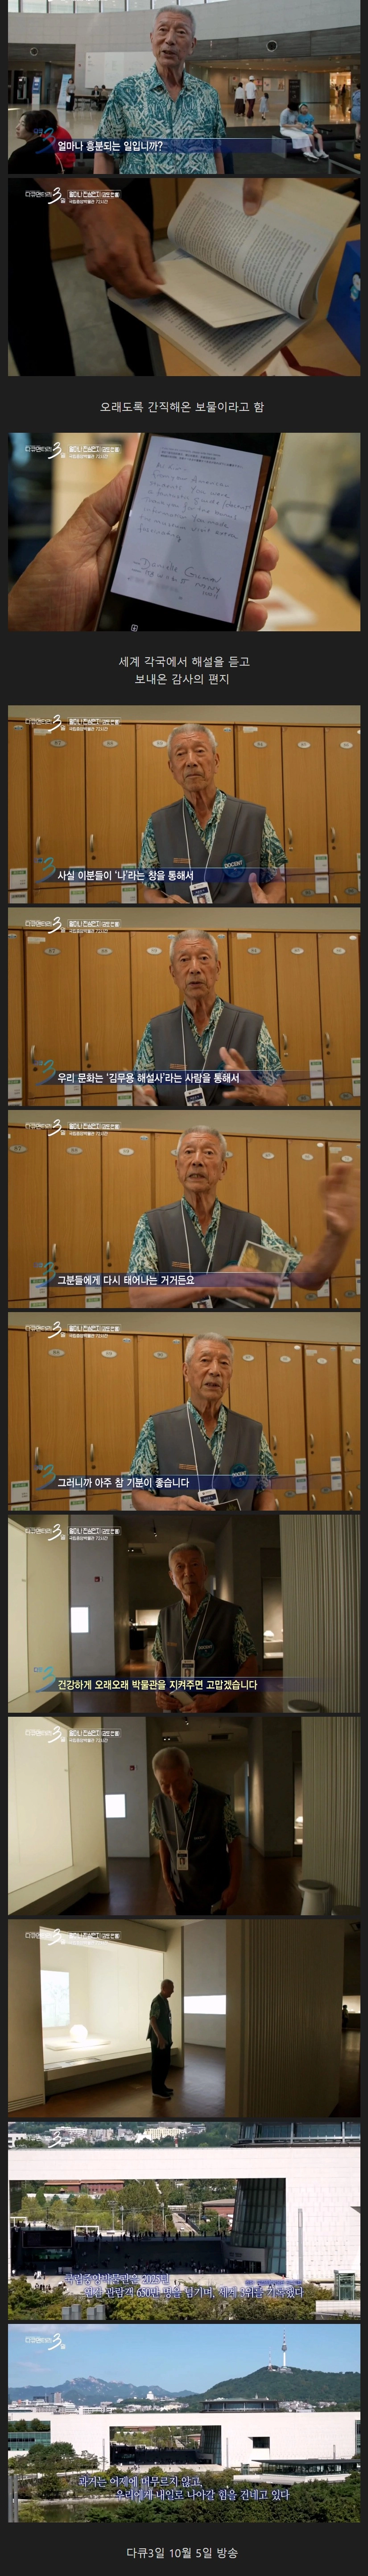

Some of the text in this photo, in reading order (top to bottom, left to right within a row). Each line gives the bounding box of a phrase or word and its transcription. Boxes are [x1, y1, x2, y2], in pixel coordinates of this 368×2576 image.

[191, 476, 229, 487] American
[157, 489, 189, 500] fantastic
[154, 519, 186, 530] museum
[224, 860, 243, 868] DOCENT
